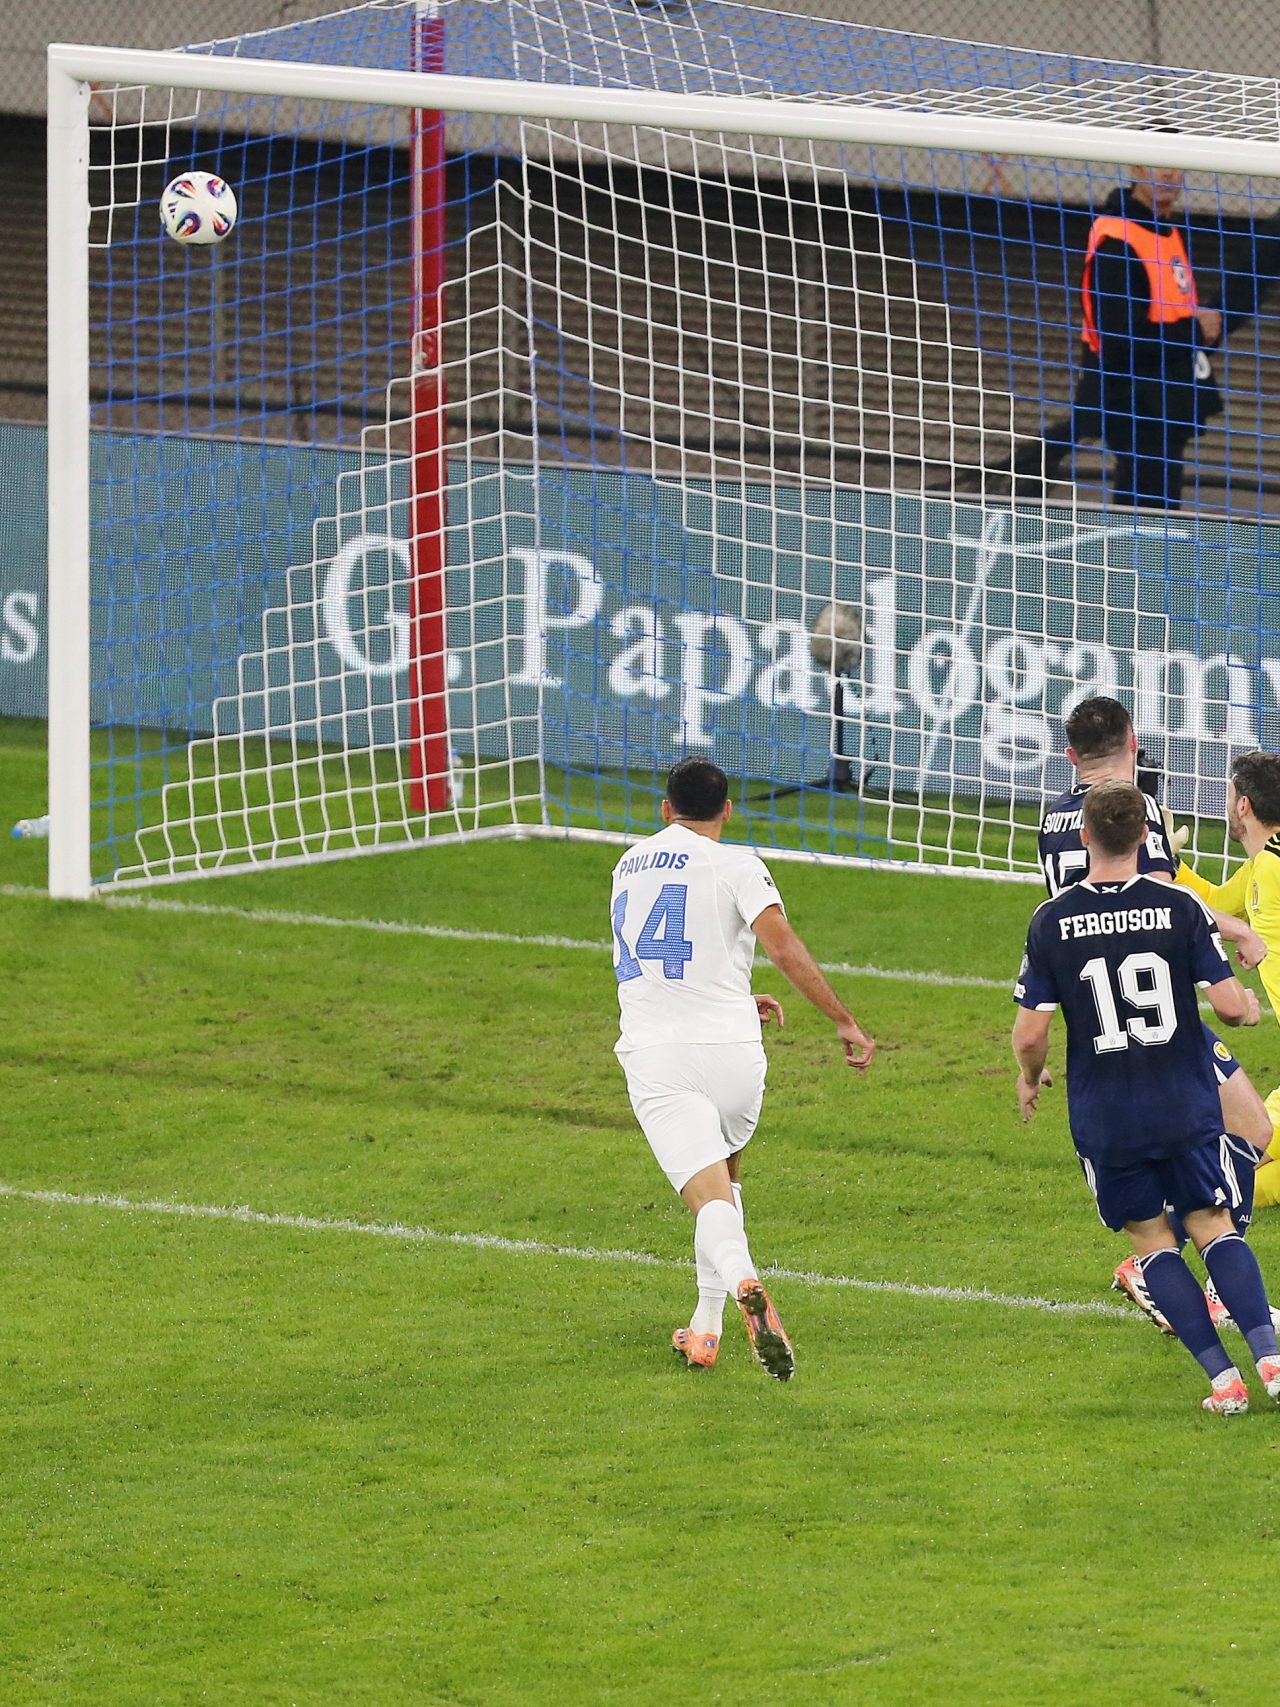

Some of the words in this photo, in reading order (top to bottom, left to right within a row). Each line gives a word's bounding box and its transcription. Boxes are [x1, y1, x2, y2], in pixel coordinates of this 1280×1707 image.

[1043, 809, 1084, 834] SOUTTA
[619, 851, 689, 880] PAVLIDIS
[612, 884, 693, 983] 14
[1058, 907, 1172, 941] FERGUSON
[1079, 951, 1178, 1055] 19
